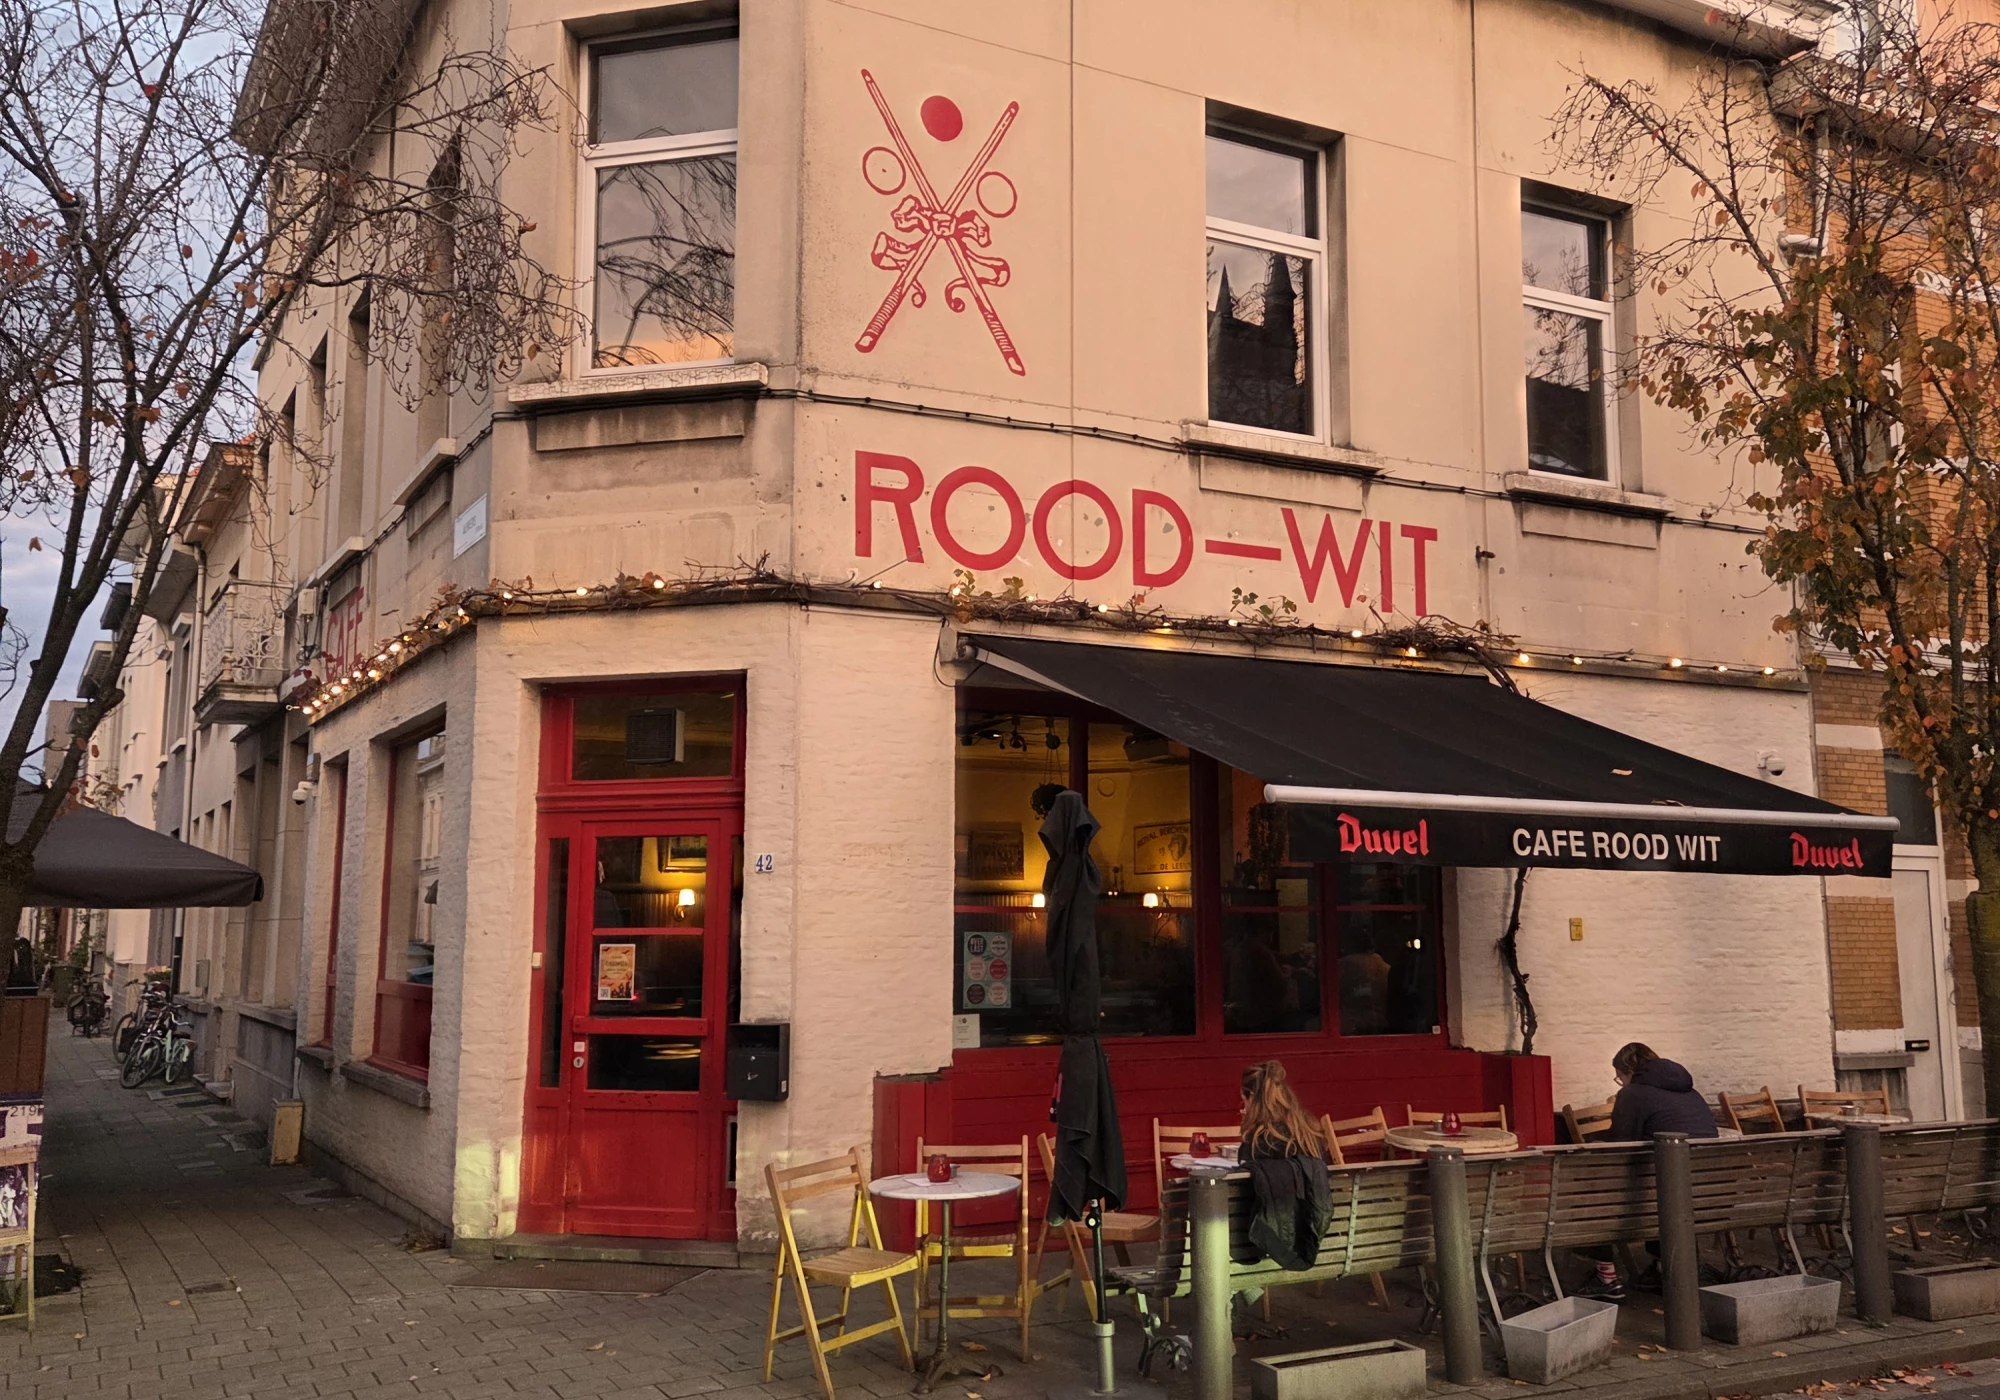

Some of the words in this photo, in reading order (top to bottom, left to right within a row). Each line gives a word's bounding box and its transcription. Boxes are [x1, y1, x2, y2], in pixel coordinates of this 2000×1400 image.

[1337, 812, 1429, 857] Duvel
[1513, 828, 1587, 857] CAFE
[1592, 831, 1669, 861] ROOD
[1674, 834, 1721, 862] WIT
[1789, 831, 1864, 869] Duvel
[756, 854, 772, 872] 42
